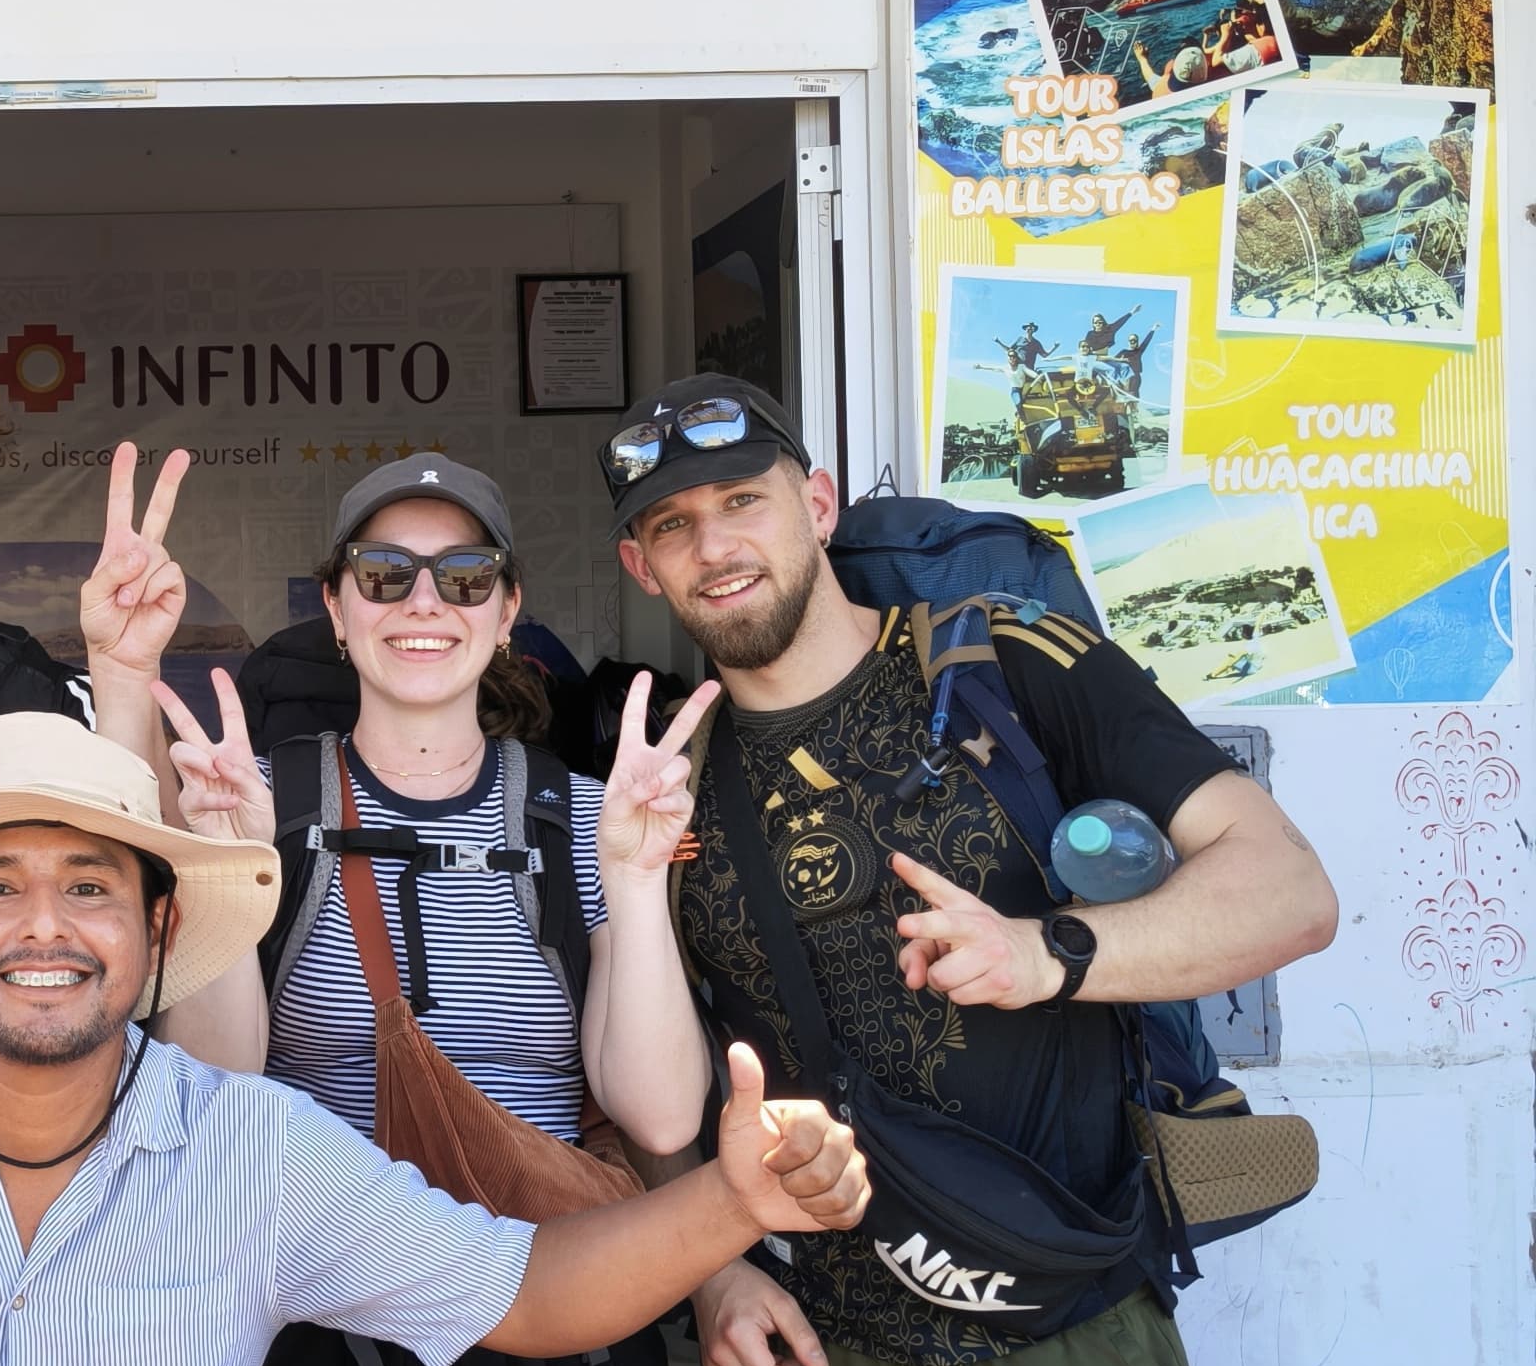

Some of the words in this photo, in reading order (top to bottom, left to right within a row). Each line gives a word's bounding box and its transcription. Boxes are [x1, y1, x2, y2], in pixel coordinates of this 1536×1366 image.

[1007, 77, 1117, 116] TOUR
[1004, 127, 1121, 165] ISLAS
[951, 175, 1179, 217] BALLESTAS
[110, 341, 451, 409] INFINITO
[1287, 403, 1396, 440] TOUR
[40, 438, 159, 469] discoer
[186, 437, 281, 466] ourself
[1214, 451, 1473, 492] HUACACHINA
[1313, 503, 1378, 540] ICA
[891, 1232, 1016, 1305] NIKE
